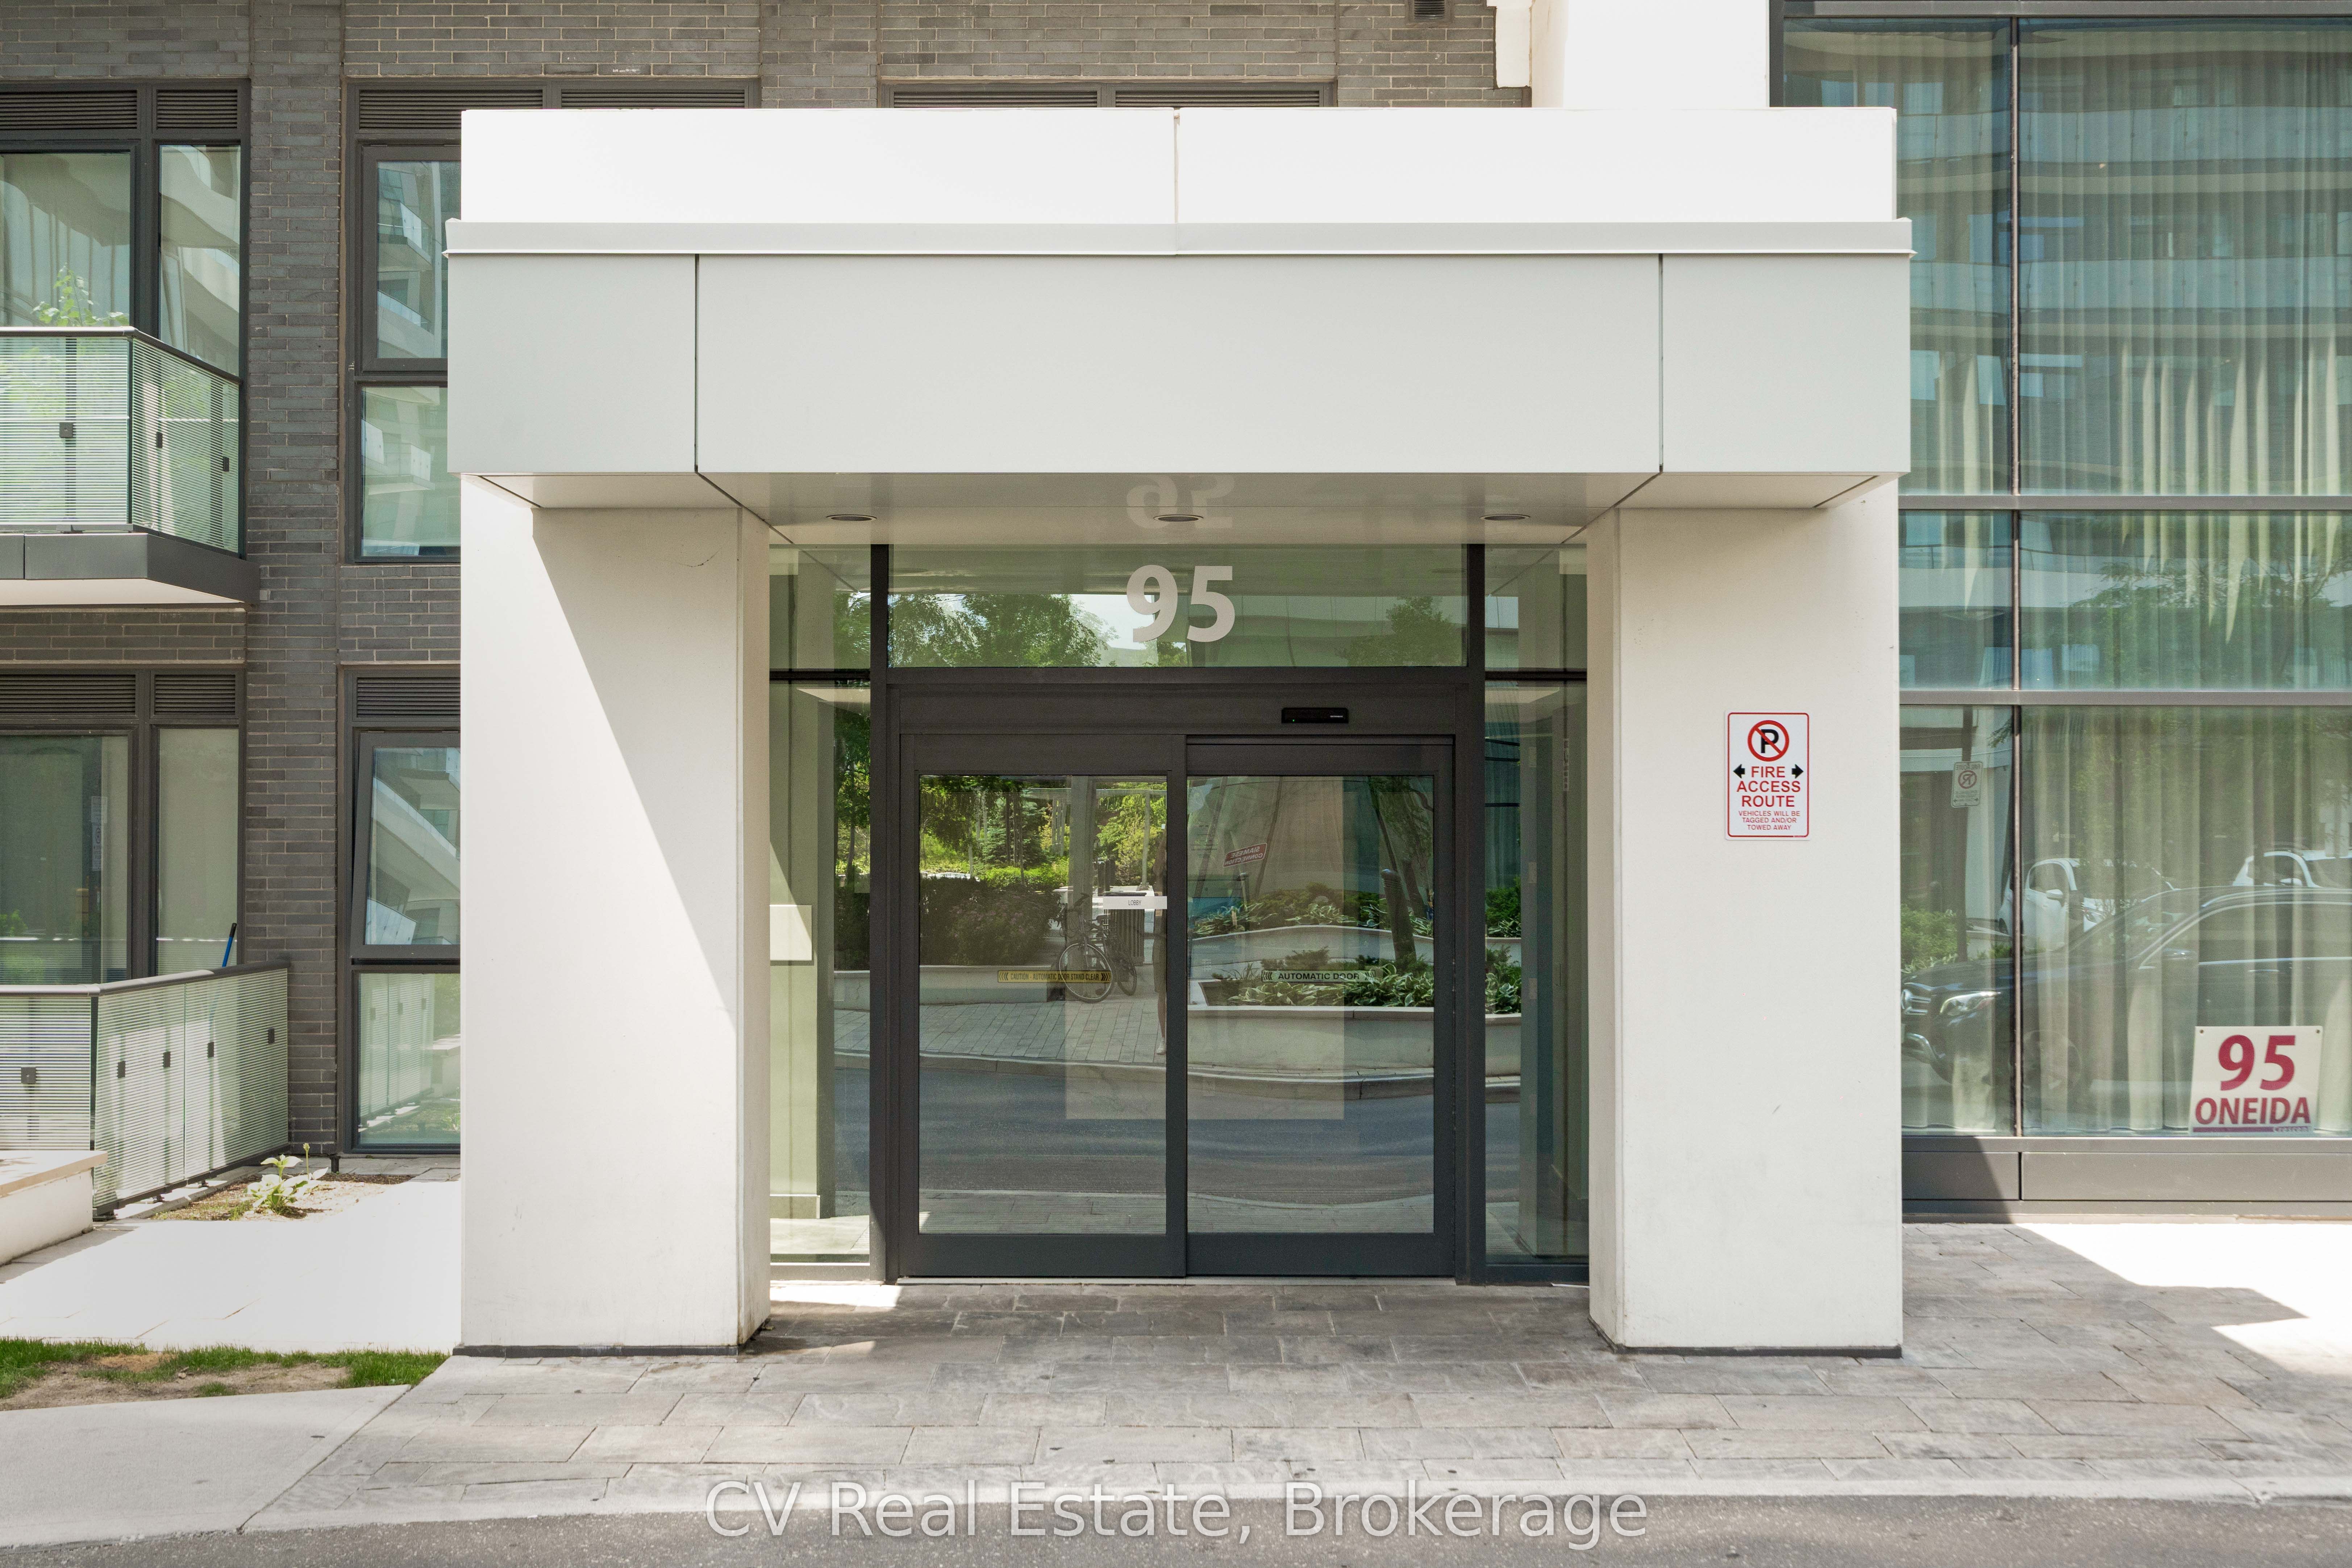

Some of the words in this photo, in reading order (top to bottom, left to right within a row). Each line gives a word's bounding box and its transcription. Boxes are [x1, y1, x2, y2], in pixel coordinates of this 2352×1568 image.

[1126, 564, 1235, 642] 95
[1751, 766, 1785, 778] FIRE
[1736, 780, 1801, 793] ACCESS
[1741, 795, 1795, 807] ROUTE
[2218, 1035, 2296, 1091] 95
[2195, 1097, 2311, 1125] ONEIDA
